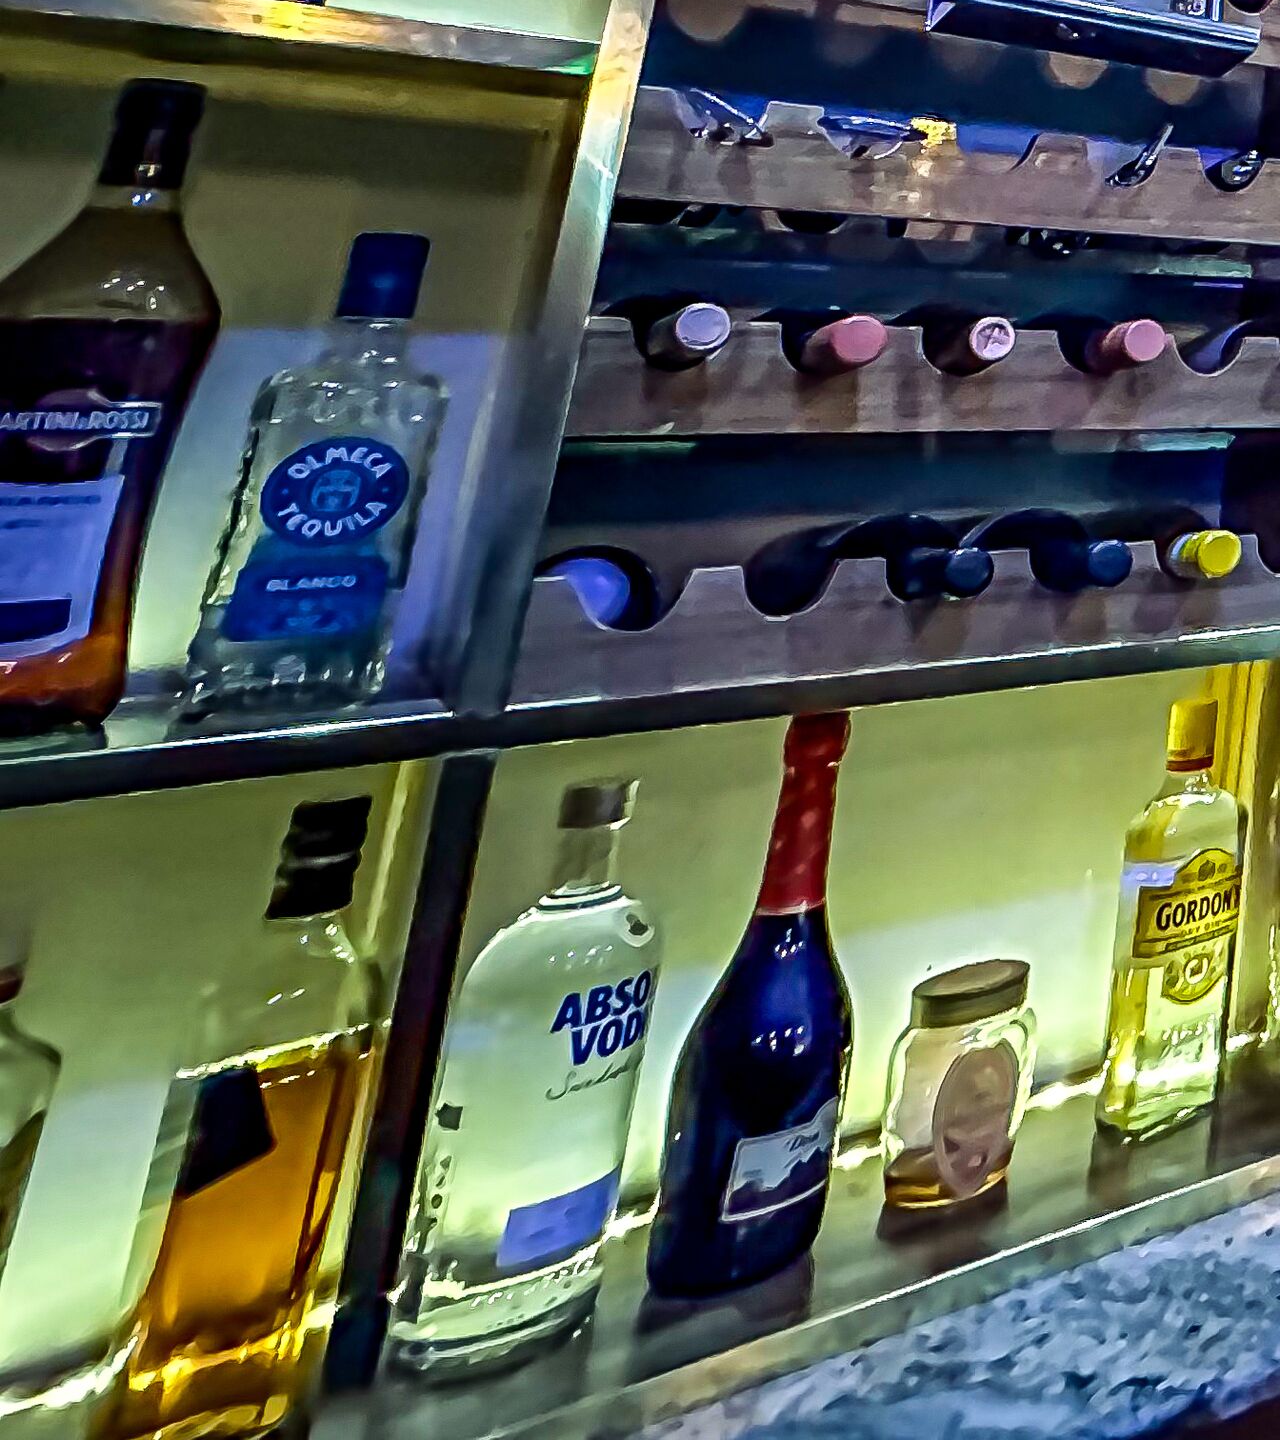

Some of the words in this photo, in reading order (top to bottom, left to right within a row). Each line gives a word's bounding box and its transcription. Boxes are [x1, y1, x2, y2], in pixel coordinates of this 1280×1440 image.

[287, 446, 394, 480] OLMECA
[277, 502, 388, 539] TEQUILA
[265, 574, 358, 593] BLANCO
